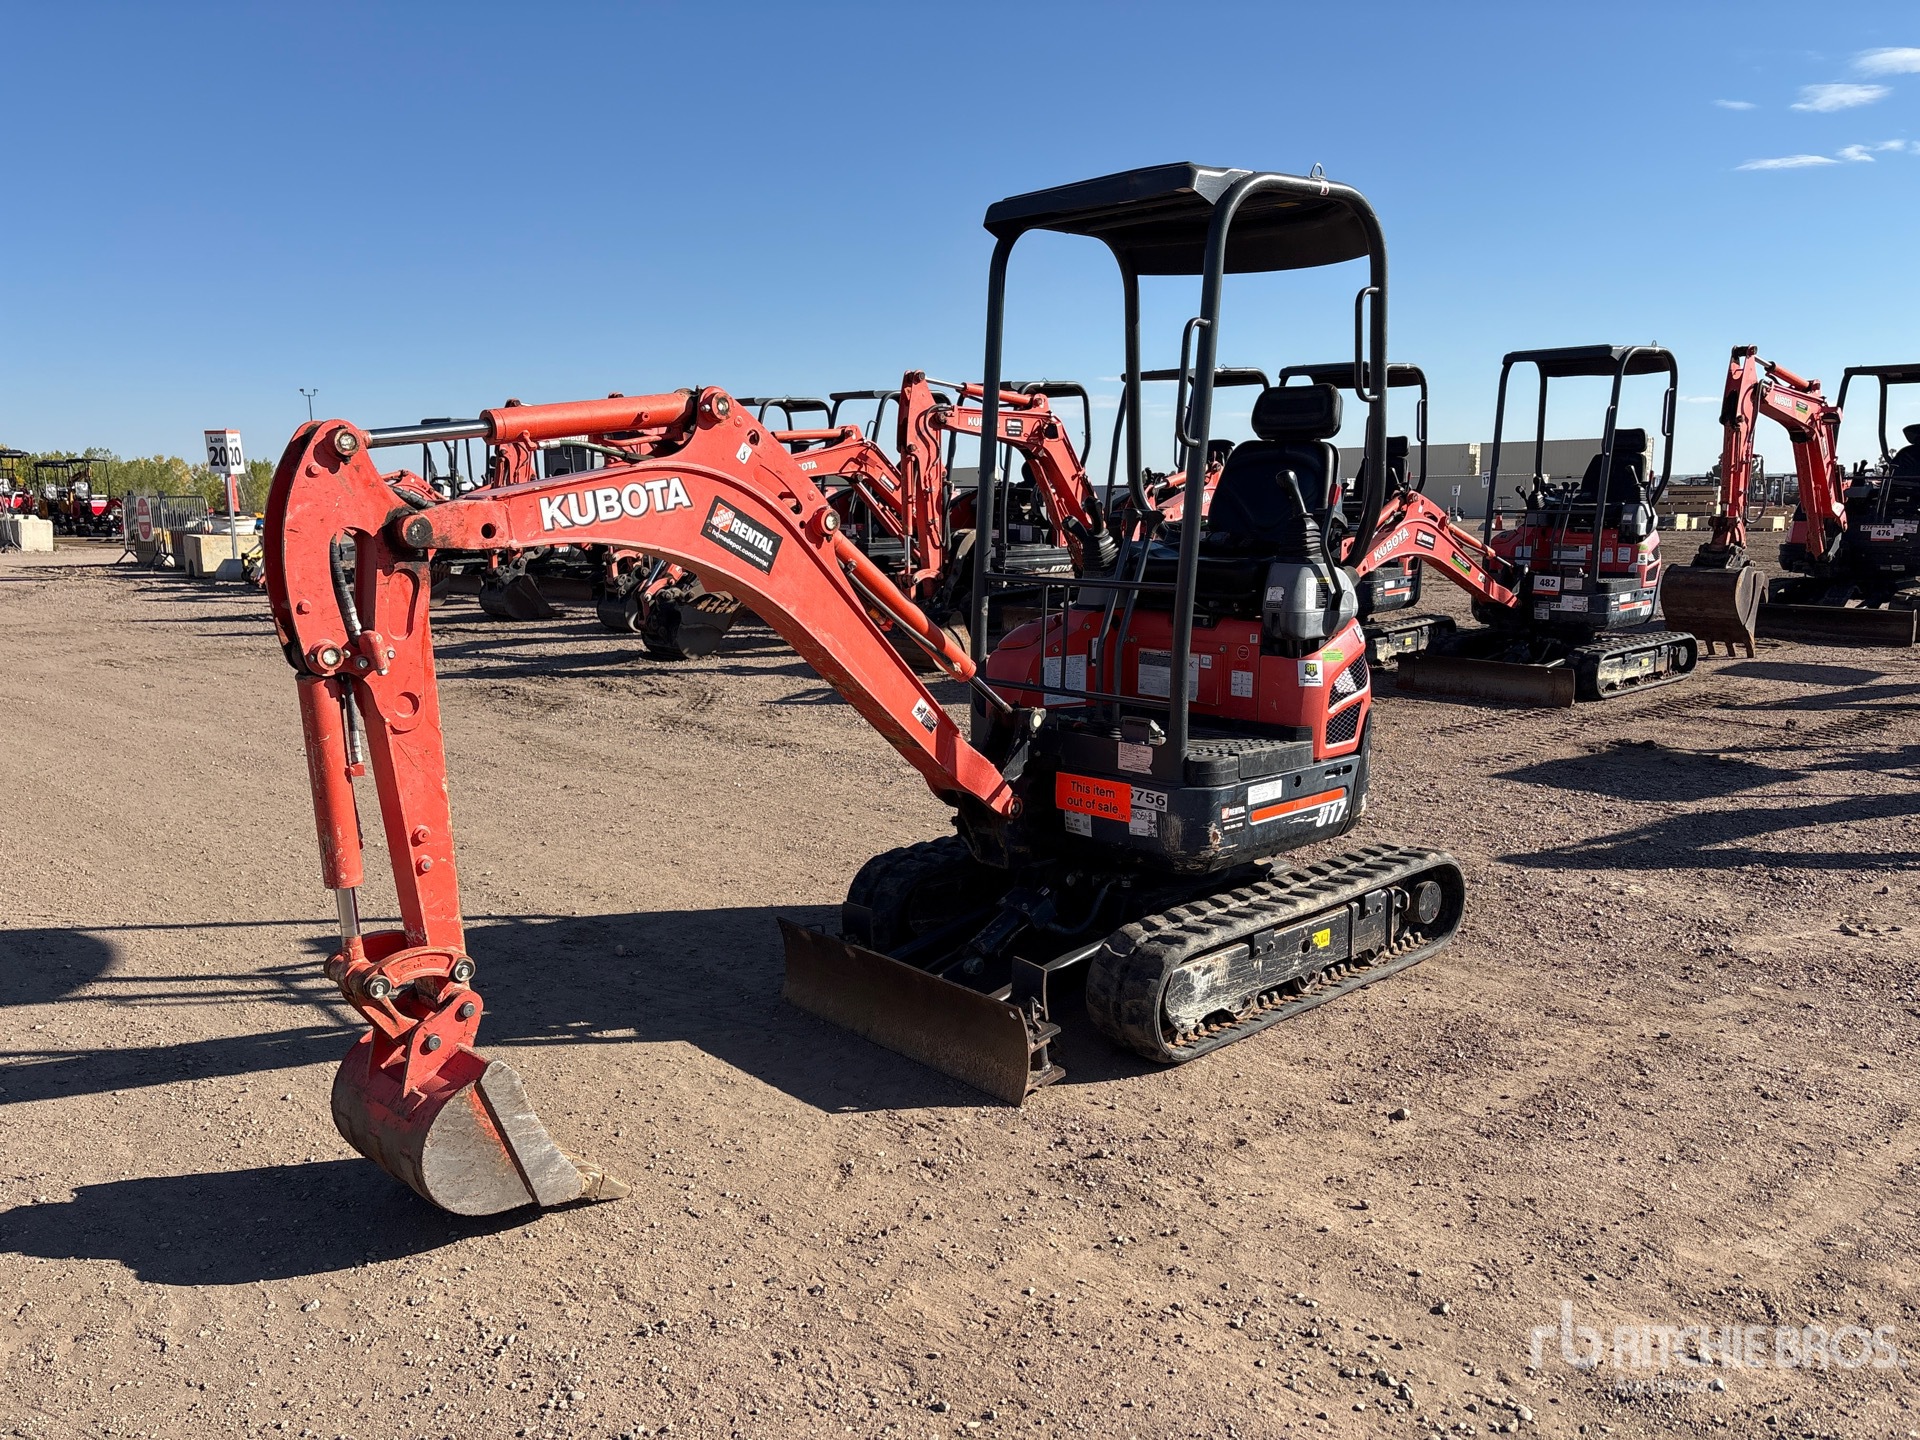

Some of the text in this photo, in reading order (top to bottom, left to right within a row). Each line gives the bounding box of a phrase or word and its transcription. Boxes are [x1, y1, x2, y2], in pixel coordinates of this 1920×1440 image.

[208, 446, 228, 467] 20
[229, 446, 242, 466] 20
[539, 476, 693, 531] KUBOTA
[730, 517, 774, 556] RENTAL
[1876, 529, 1891, 537] 476
[1373, 526, 1411, 562] KUBOTA
[1539, 578, 1556, 588] 482
[1070, 780, 1116, 799] This item
[1067, 797, 1119, 814] out of sale
[1315, 800, 1347, 828] U17
